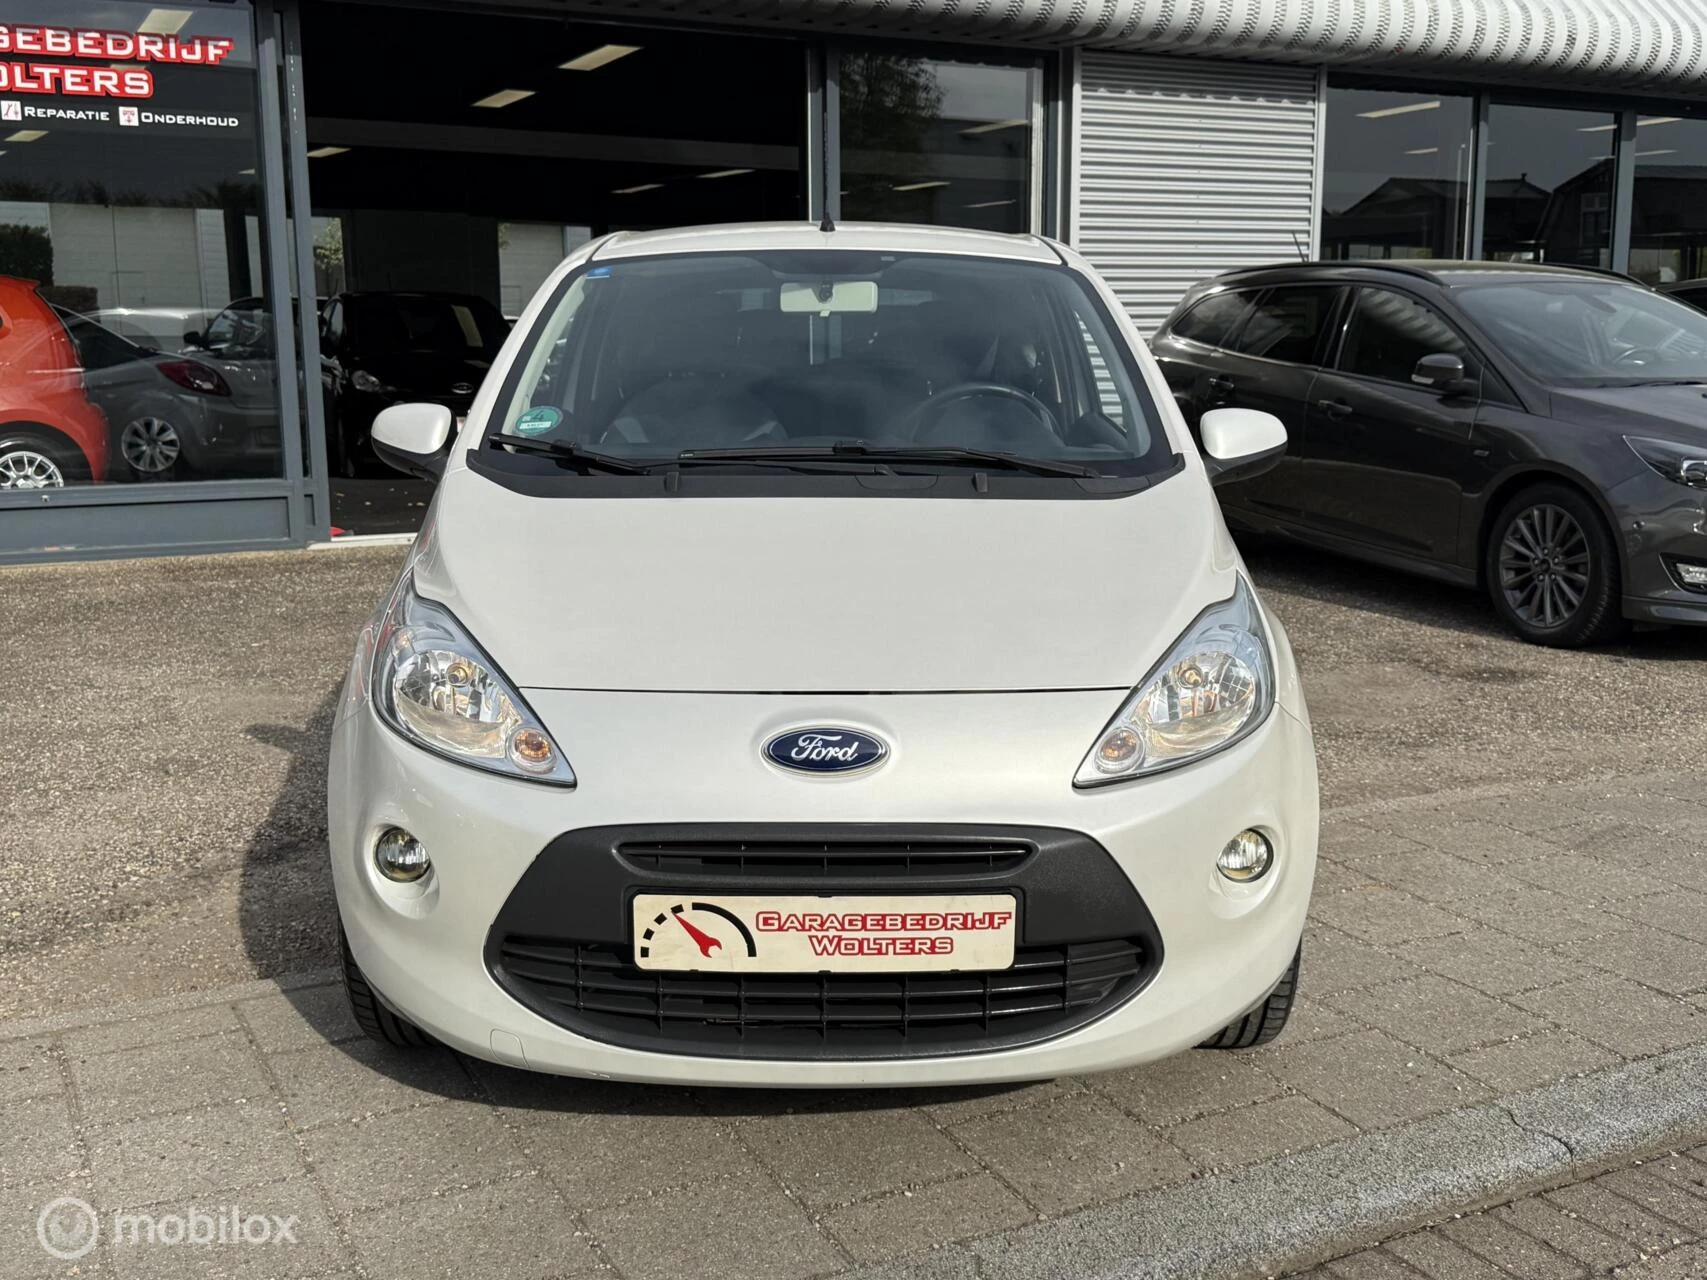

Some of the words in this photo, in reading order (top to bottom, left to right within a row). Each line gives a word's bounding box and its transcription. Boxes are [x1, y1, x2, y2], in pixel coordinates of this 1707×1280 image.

[24, 106, 110, 121] REPARATIE
[141, 111, 239, 127] ONDERHOUD
[790, 733, 859, 761] Ford
[756, 911, 1012, 932] GARAGEBEDRIJF
[809, 935, 953, 956] WOLTERS
